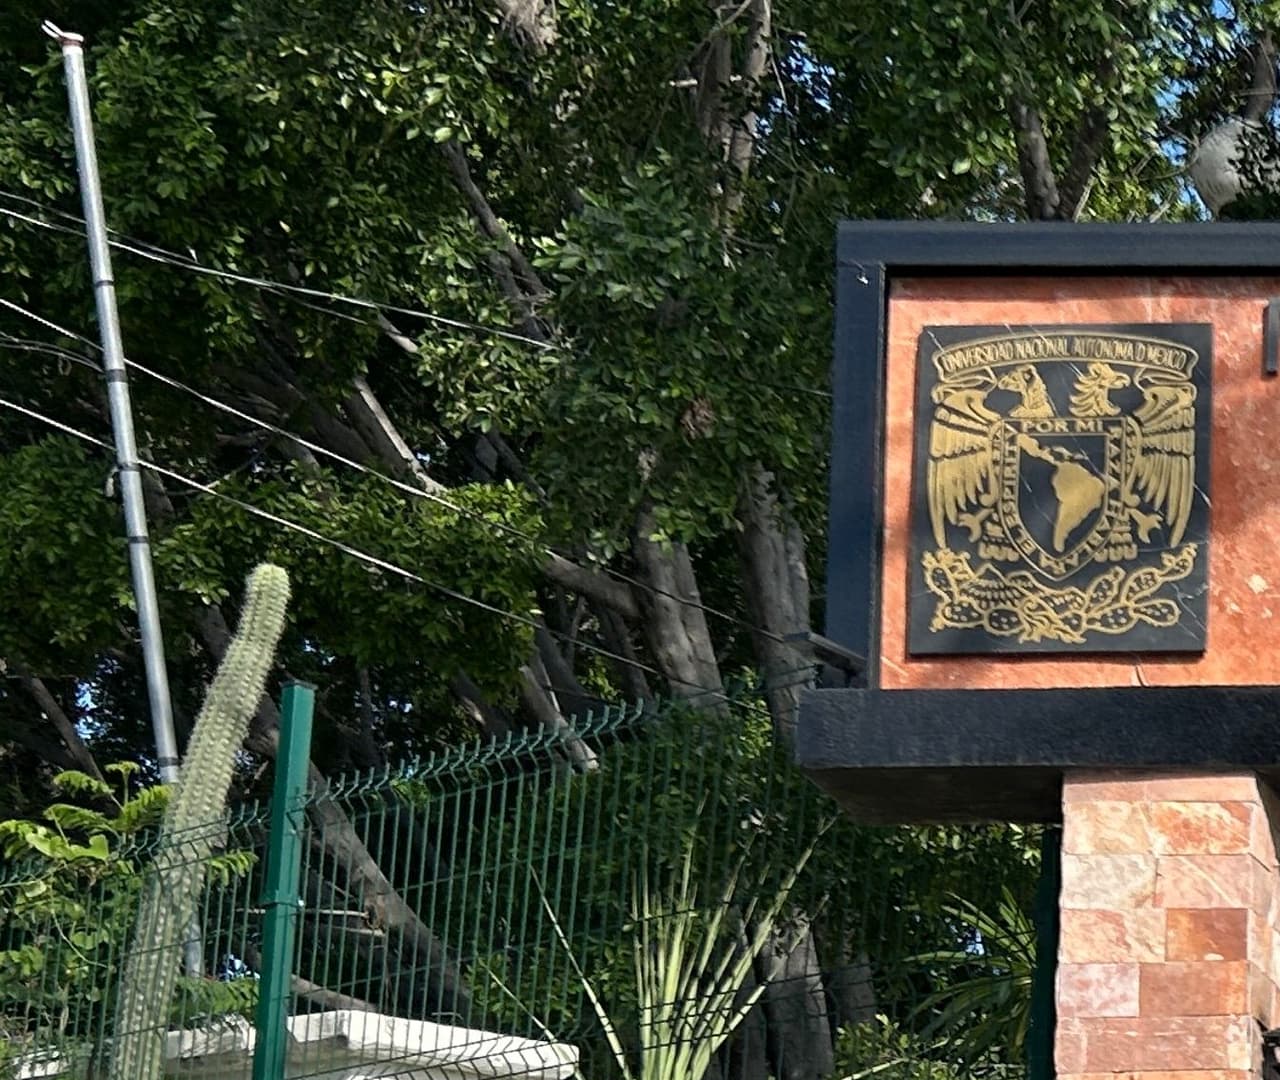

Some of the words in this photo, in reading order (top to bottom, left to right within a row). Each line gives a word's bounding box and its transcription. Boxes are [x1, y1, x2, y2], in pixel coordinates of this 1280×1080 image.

[1015, 337, 1069, 359] NACIONAL
[1022, 420, 1069, 433] POR
[1076, 420, 1104, 433] MI
